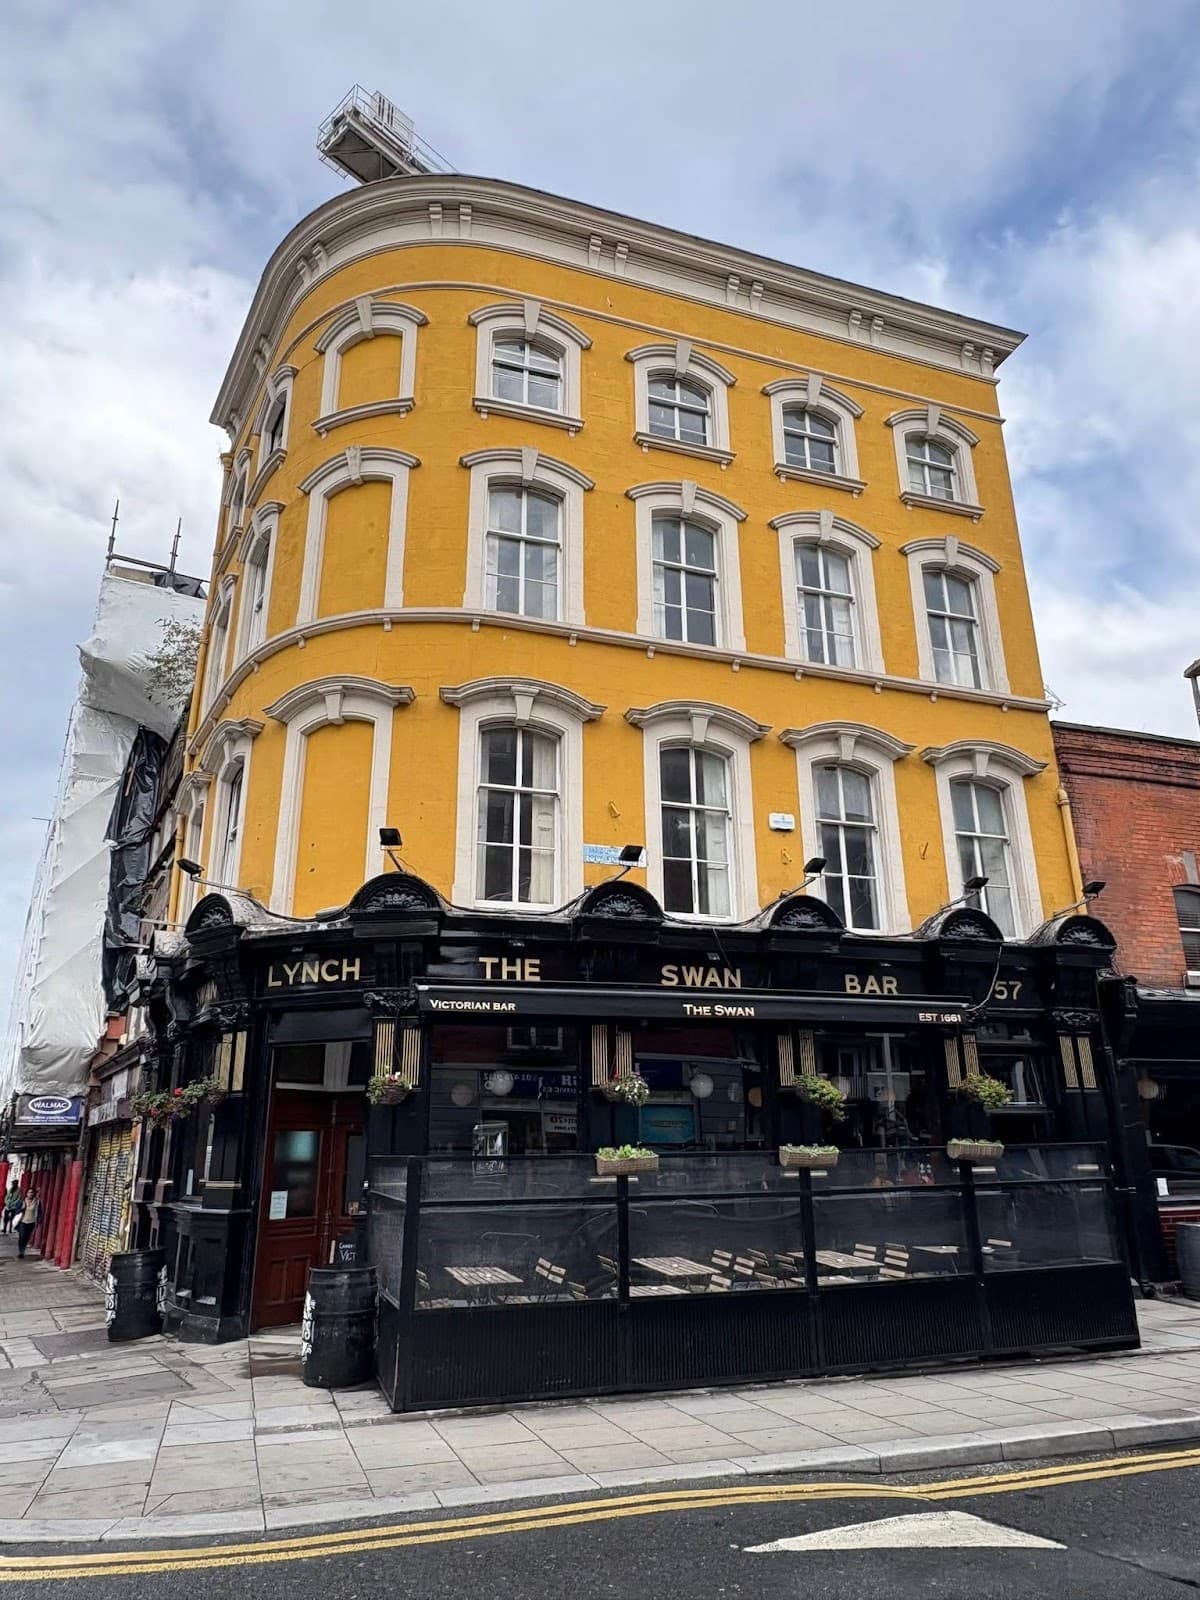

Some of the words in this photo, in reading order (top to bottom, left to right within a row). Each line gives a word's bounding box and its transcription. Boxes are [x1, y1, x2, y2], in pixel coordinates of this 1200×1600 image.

[268, 958, 360, 988] LYNCH
[478, 957, 541, 981] THE
[660, 965, 742, 988] SWAN
[845, 973, 899, 996] BAR
[993, 980, 1023, 1001] 57
[430, 999, 491, 1011] VICTORIAN
[493, 1002, 517, 1012] BAR
[683, 1004, 712, 1016] THE
[713, 1004, 755, 1018] SWAN
[918, 1013, 938, 1022] EST
[940, 1013, 962, 1023] 1661
[34, 1100, 66, 1109] WALMAC
